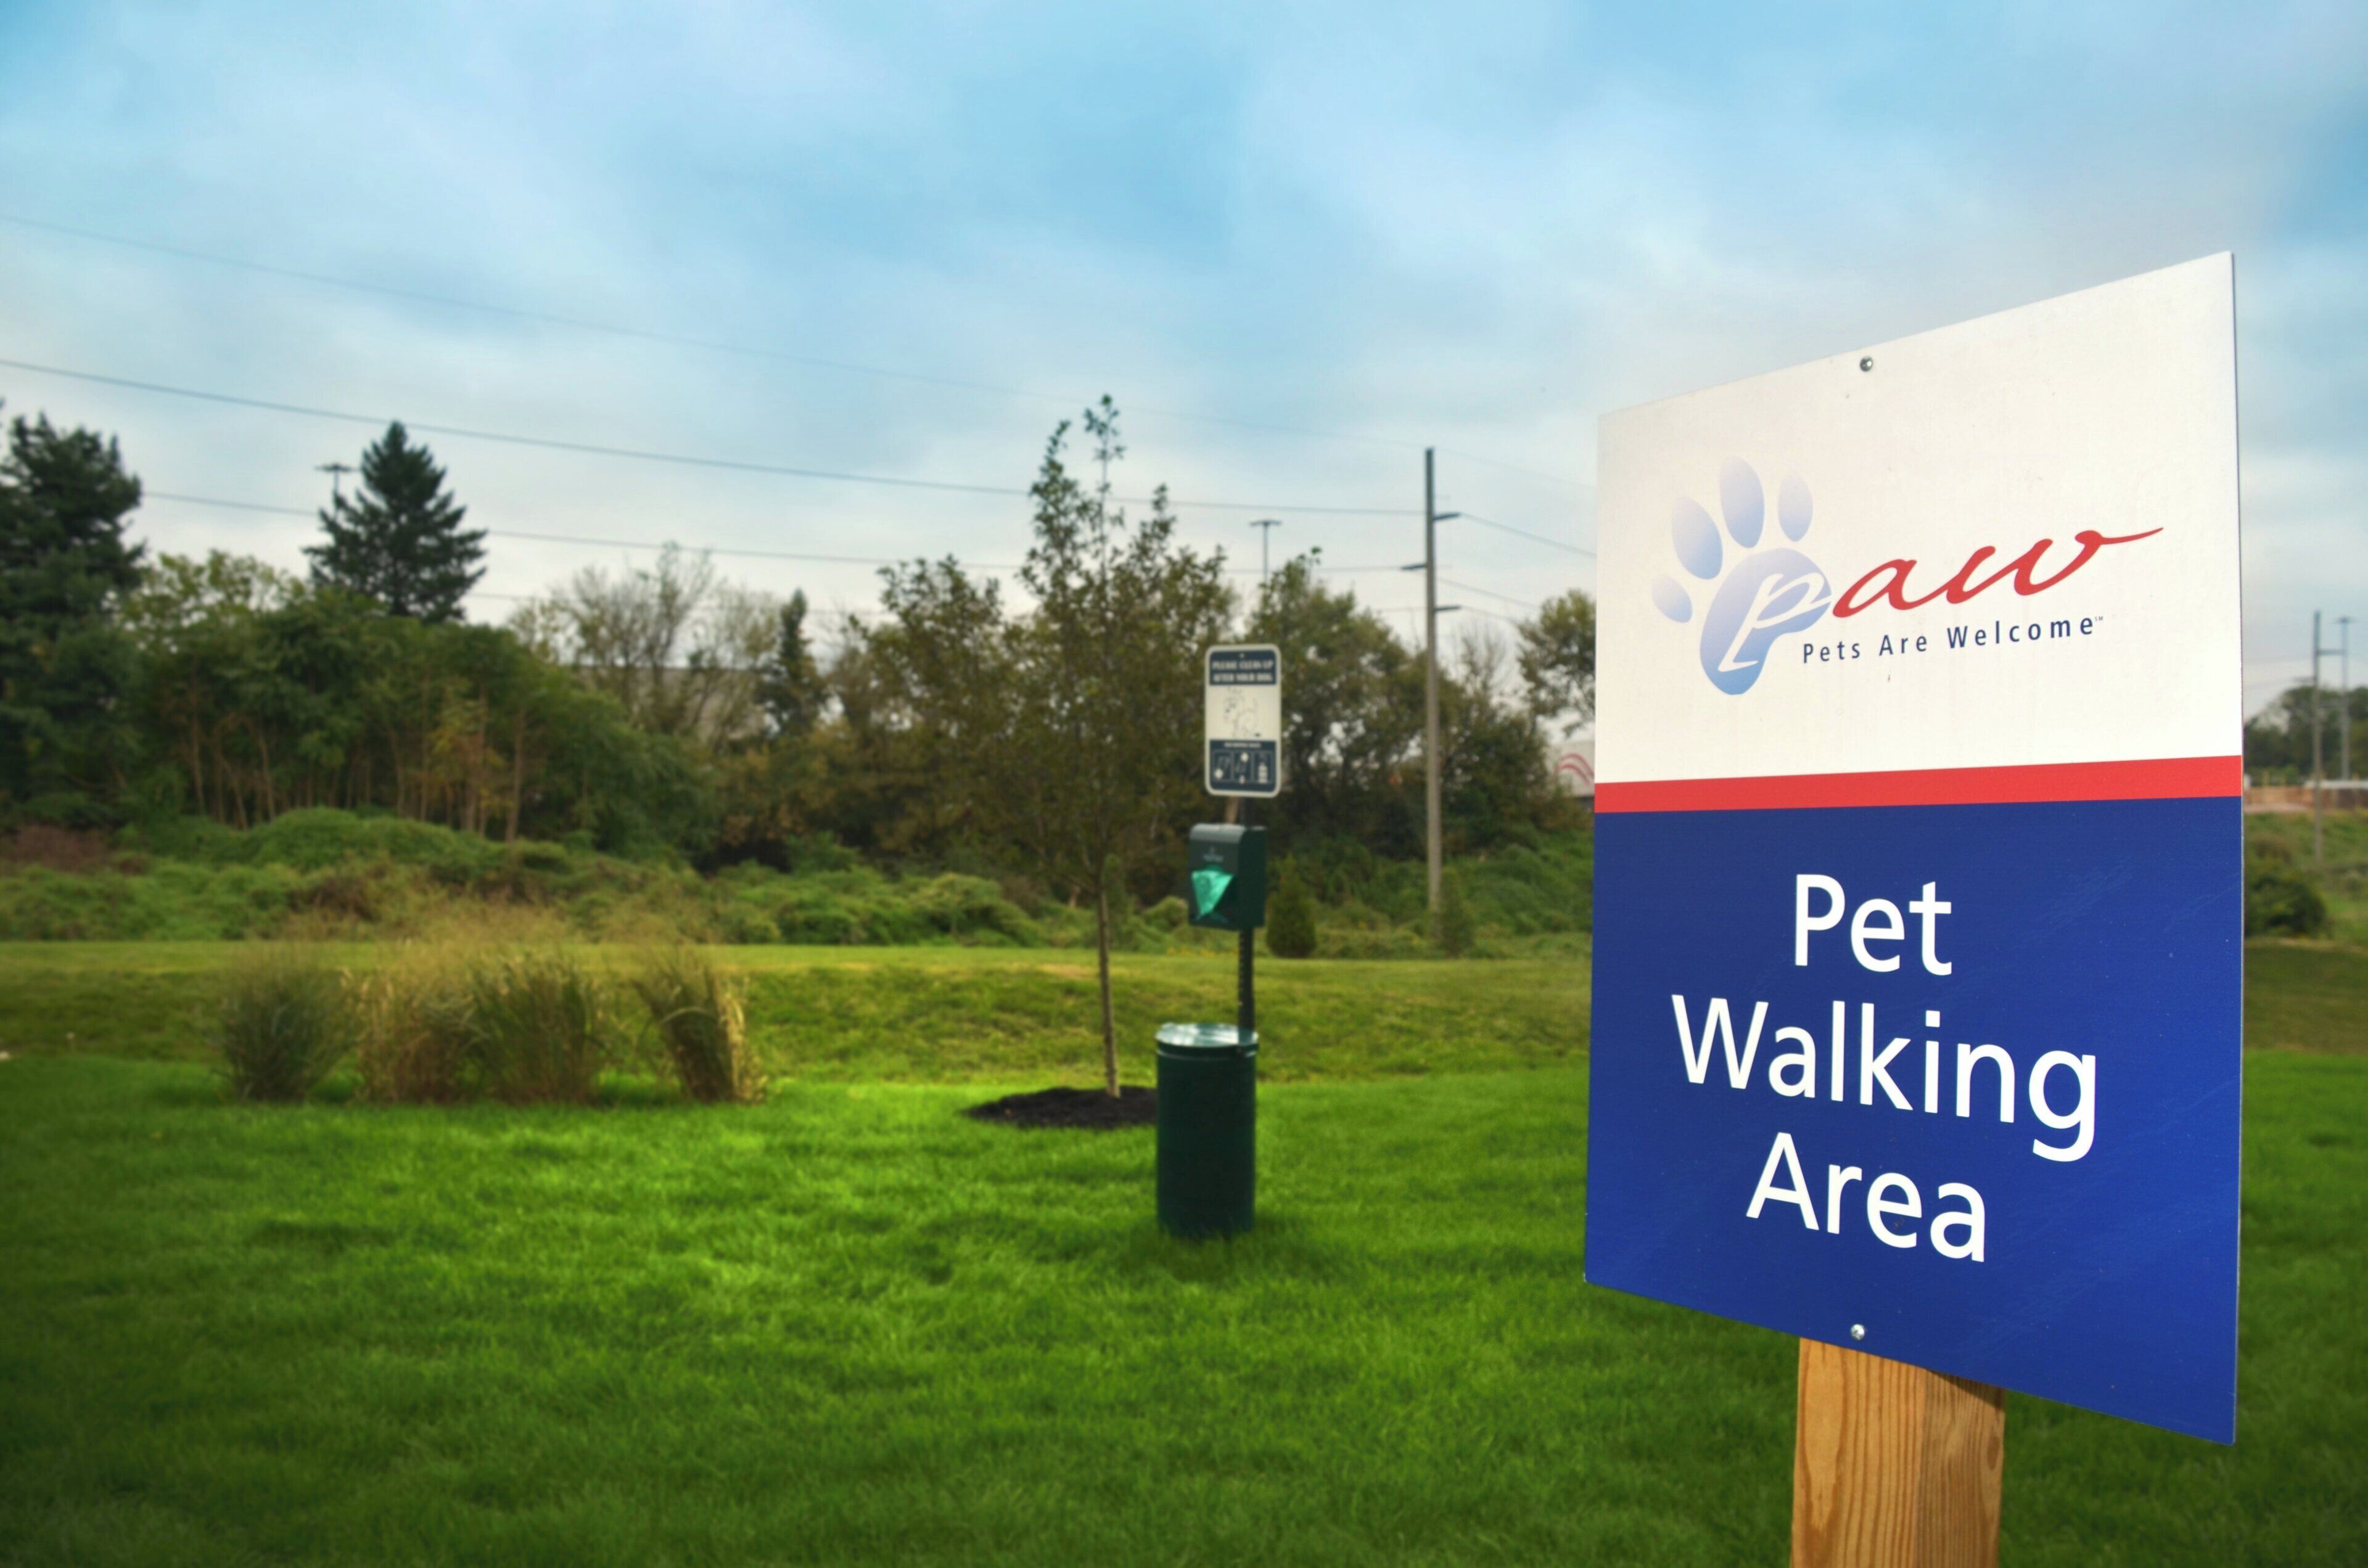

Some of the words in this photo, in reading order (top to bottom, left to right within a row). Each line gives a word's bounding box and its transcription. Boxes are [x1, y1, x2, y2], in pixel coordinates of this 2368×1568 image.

[1803, 641, 1860, 664] Pets
[1879, 634, 1928, 656] Are
[1947, 617, 2094, 649] Welcome
[1794, 873, 1952, 976] Pet
[1671, 993, 2097, 1162] Walking
[1745, 1131, 1986, 1263] Area
